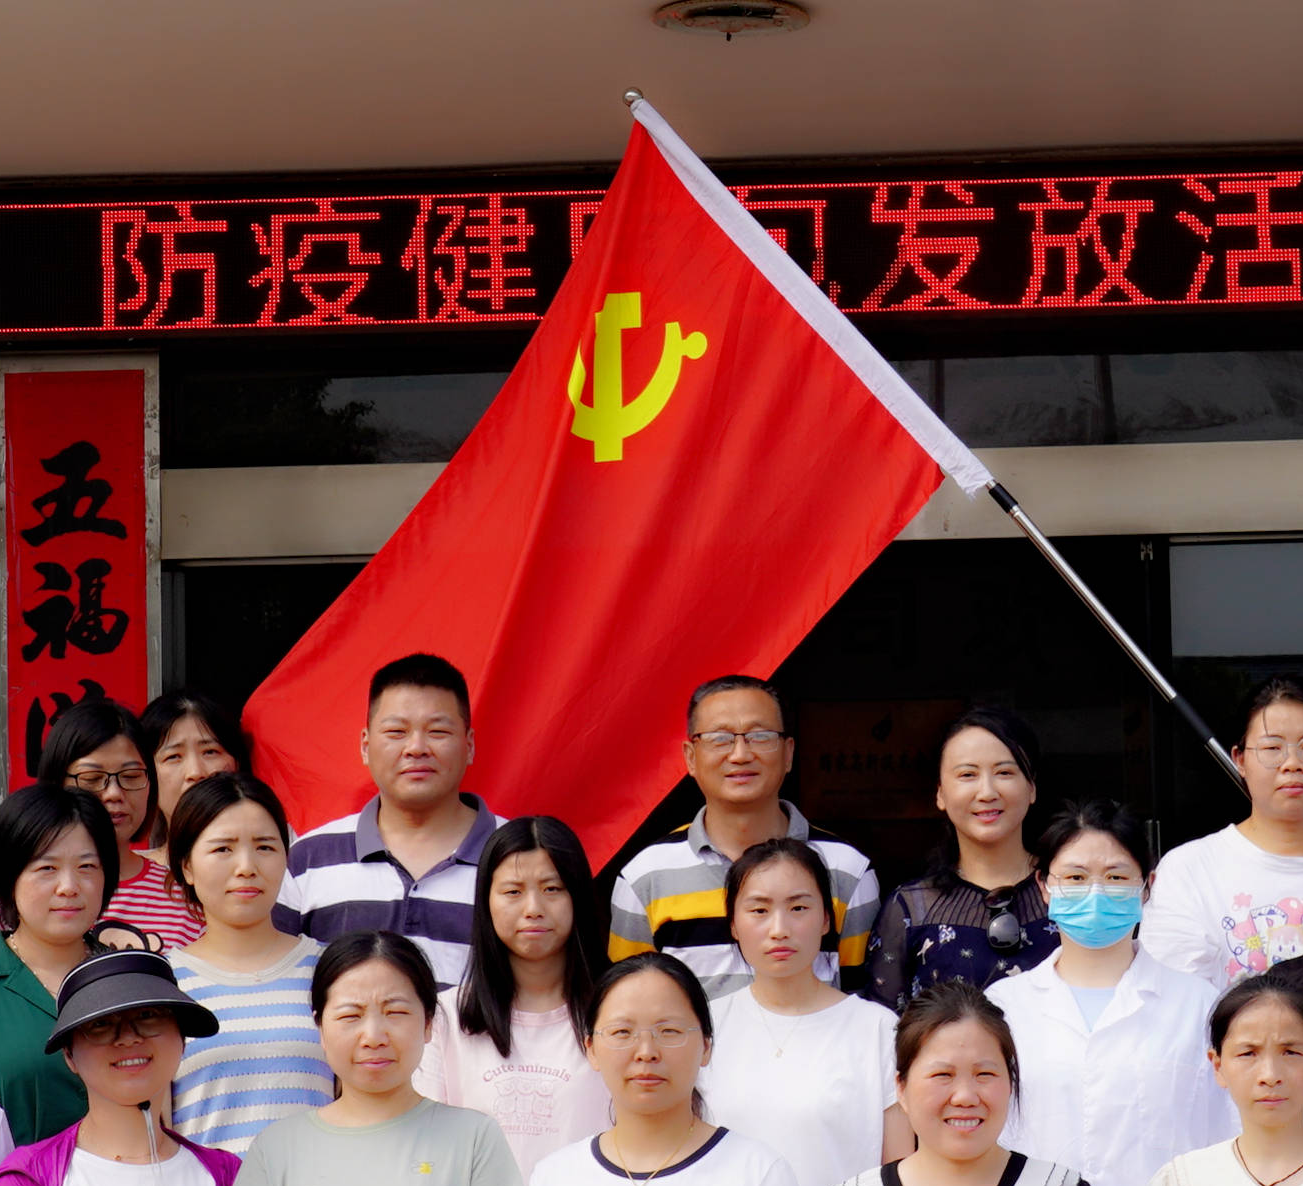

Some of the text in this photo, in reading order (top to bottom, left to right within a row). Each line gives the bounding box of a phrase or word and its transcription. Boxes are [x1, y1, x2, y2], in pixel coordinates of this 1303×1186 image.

[21, 440, 129, 779] 五福
[483, 1063, 572, 1082] Cute animals
